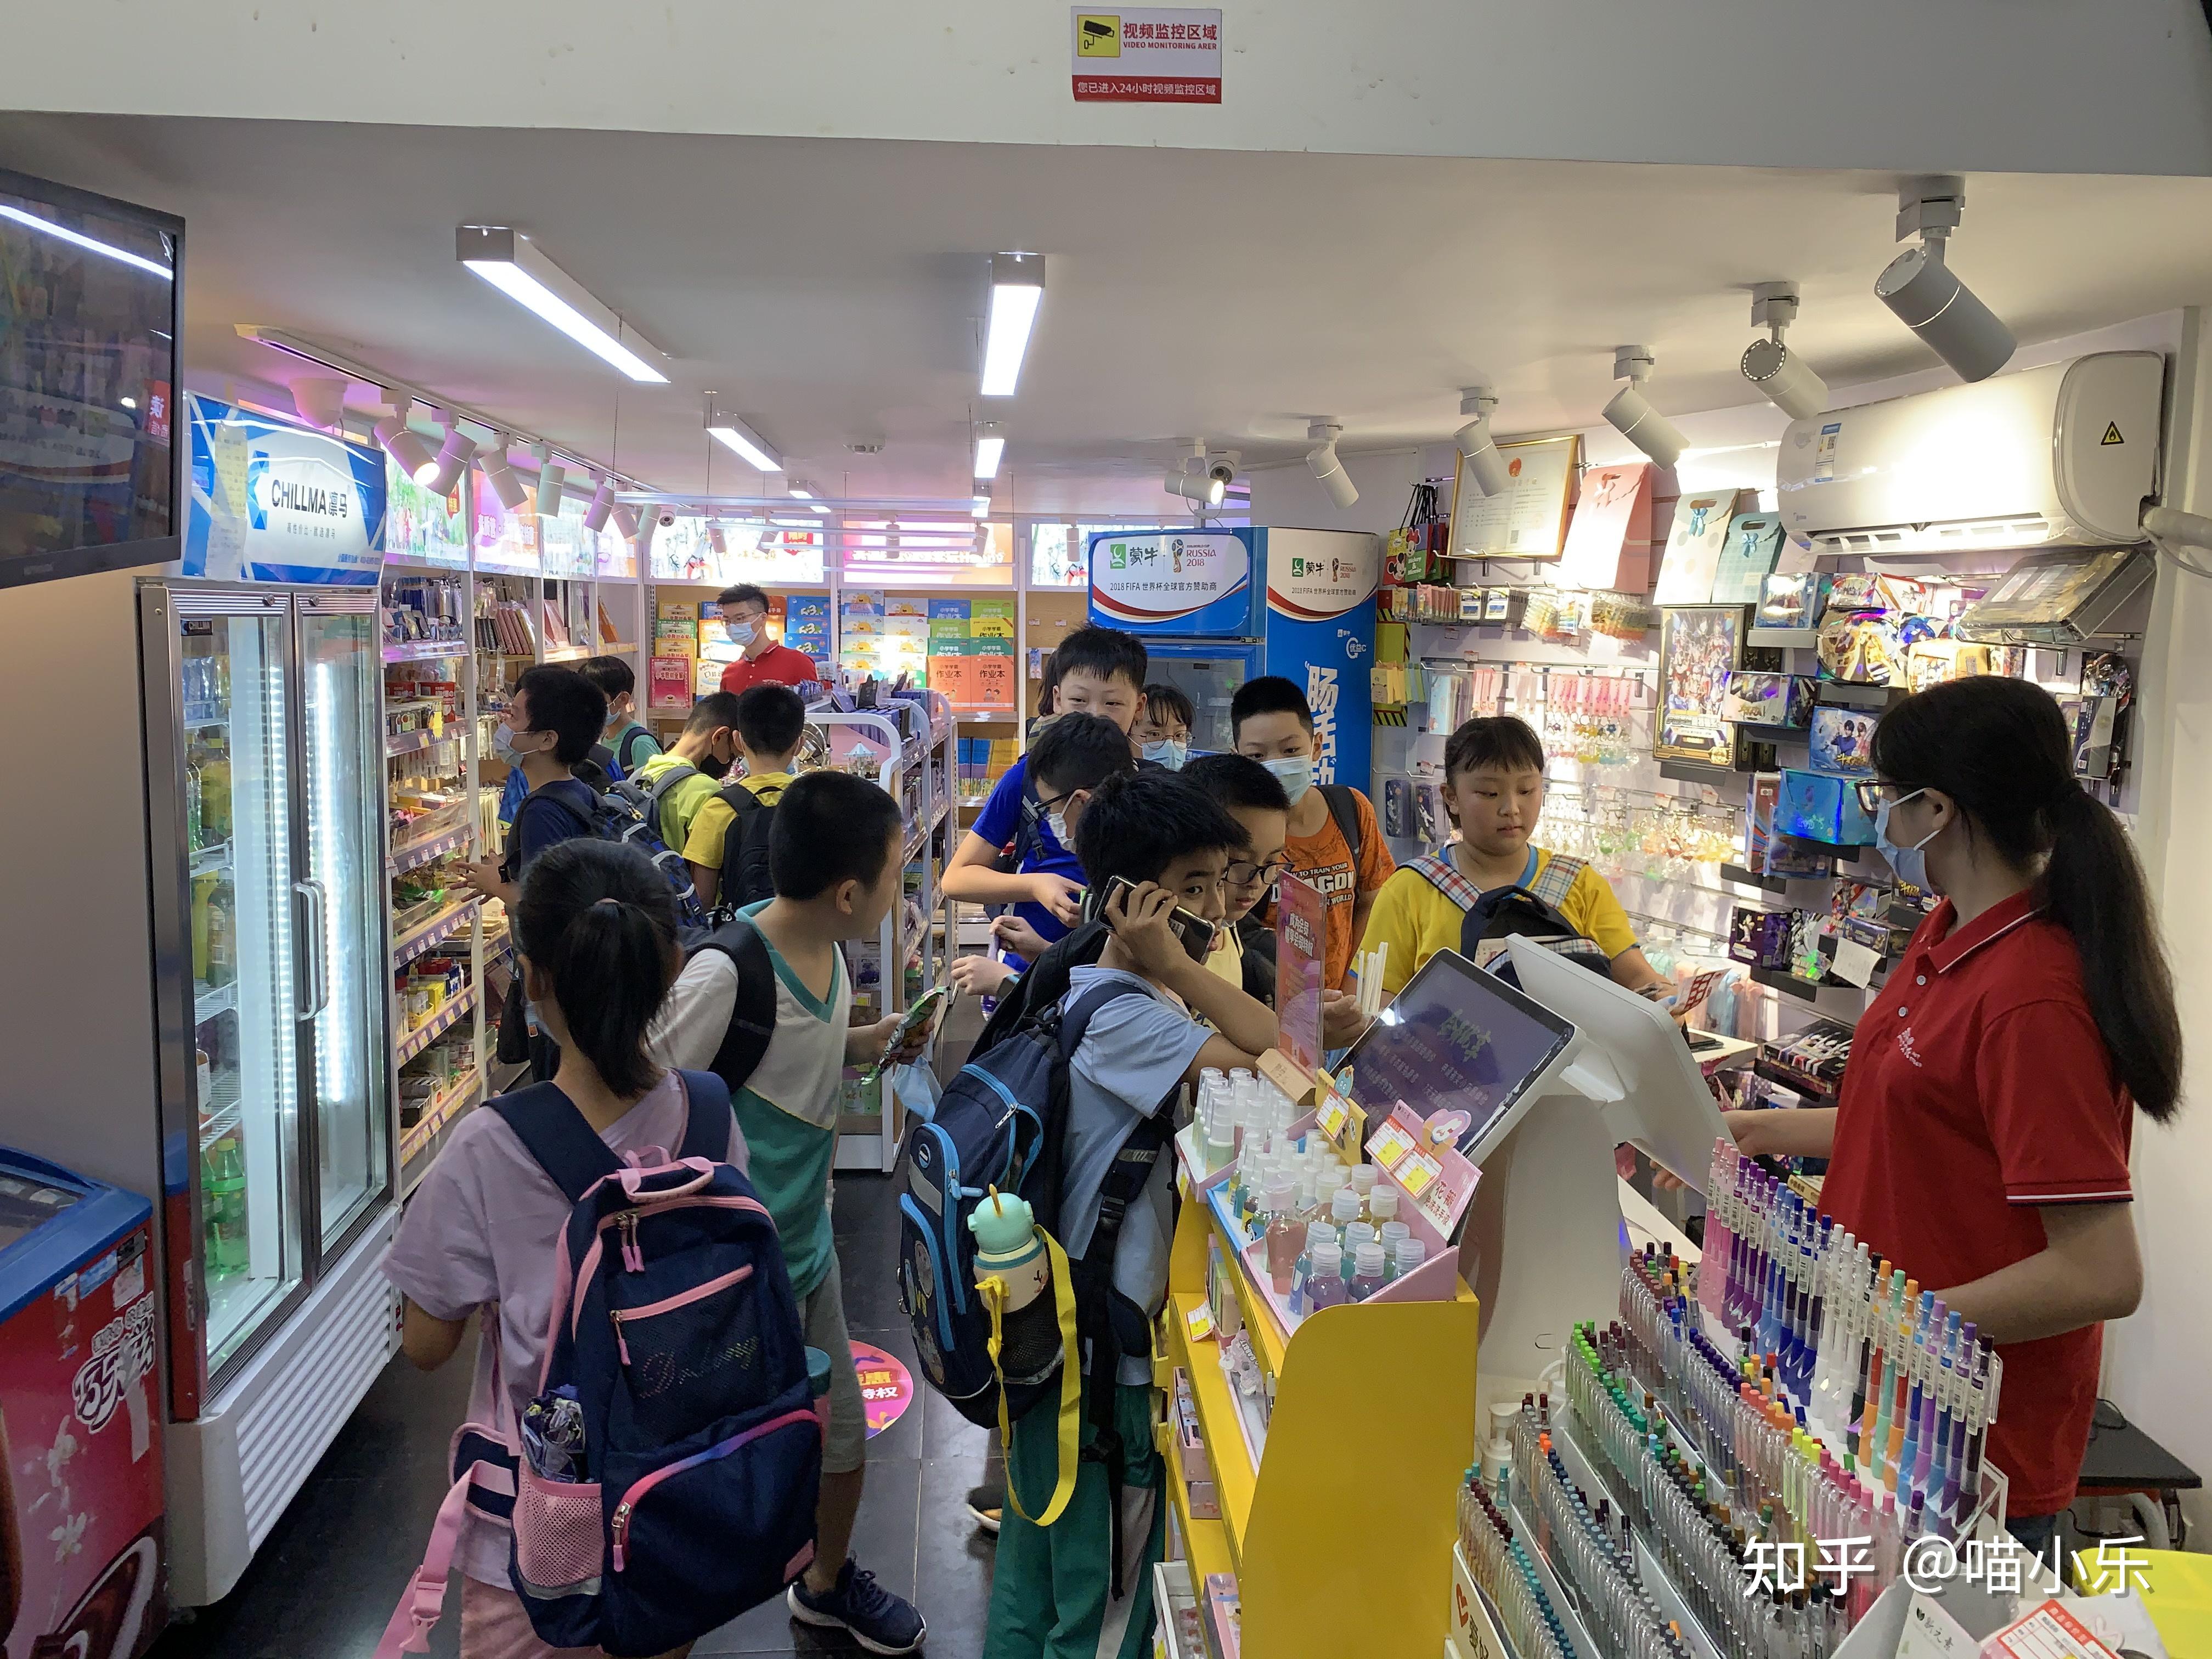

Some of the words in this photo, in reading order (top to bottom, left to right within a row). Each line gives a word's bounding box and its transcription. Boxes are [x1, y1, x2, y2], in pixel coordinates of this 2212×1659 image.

[1123, 23, 1217, 41] 视频监控区域
[1077, 82, 1216, 96] 您已进入24小时视频监控区域
[272, 479, 326, 515] CHILLMA
[1130, 547, 1158, 567] 蒙牛
[1186, 549, 1216, 557] RUSSIA
[1186, 558, 1205, 567] 2018
[1306, 561, 1324, 577] 蒙牛
[1110, 583, 1124, 591] 2018
[1126, 583, 1141, 591] FIFA
[1142, 582, 1217, 591] 世界杯全球官方赞助商
[936, 670, 962, 678] 作业本
[979, 670, 1005, 678] 作业本
[1310, 866, 1331, 876] TRAIN
[1331, 862, 1348, 871] YOUR
[1331, 893, 1353, 905] WORLD
